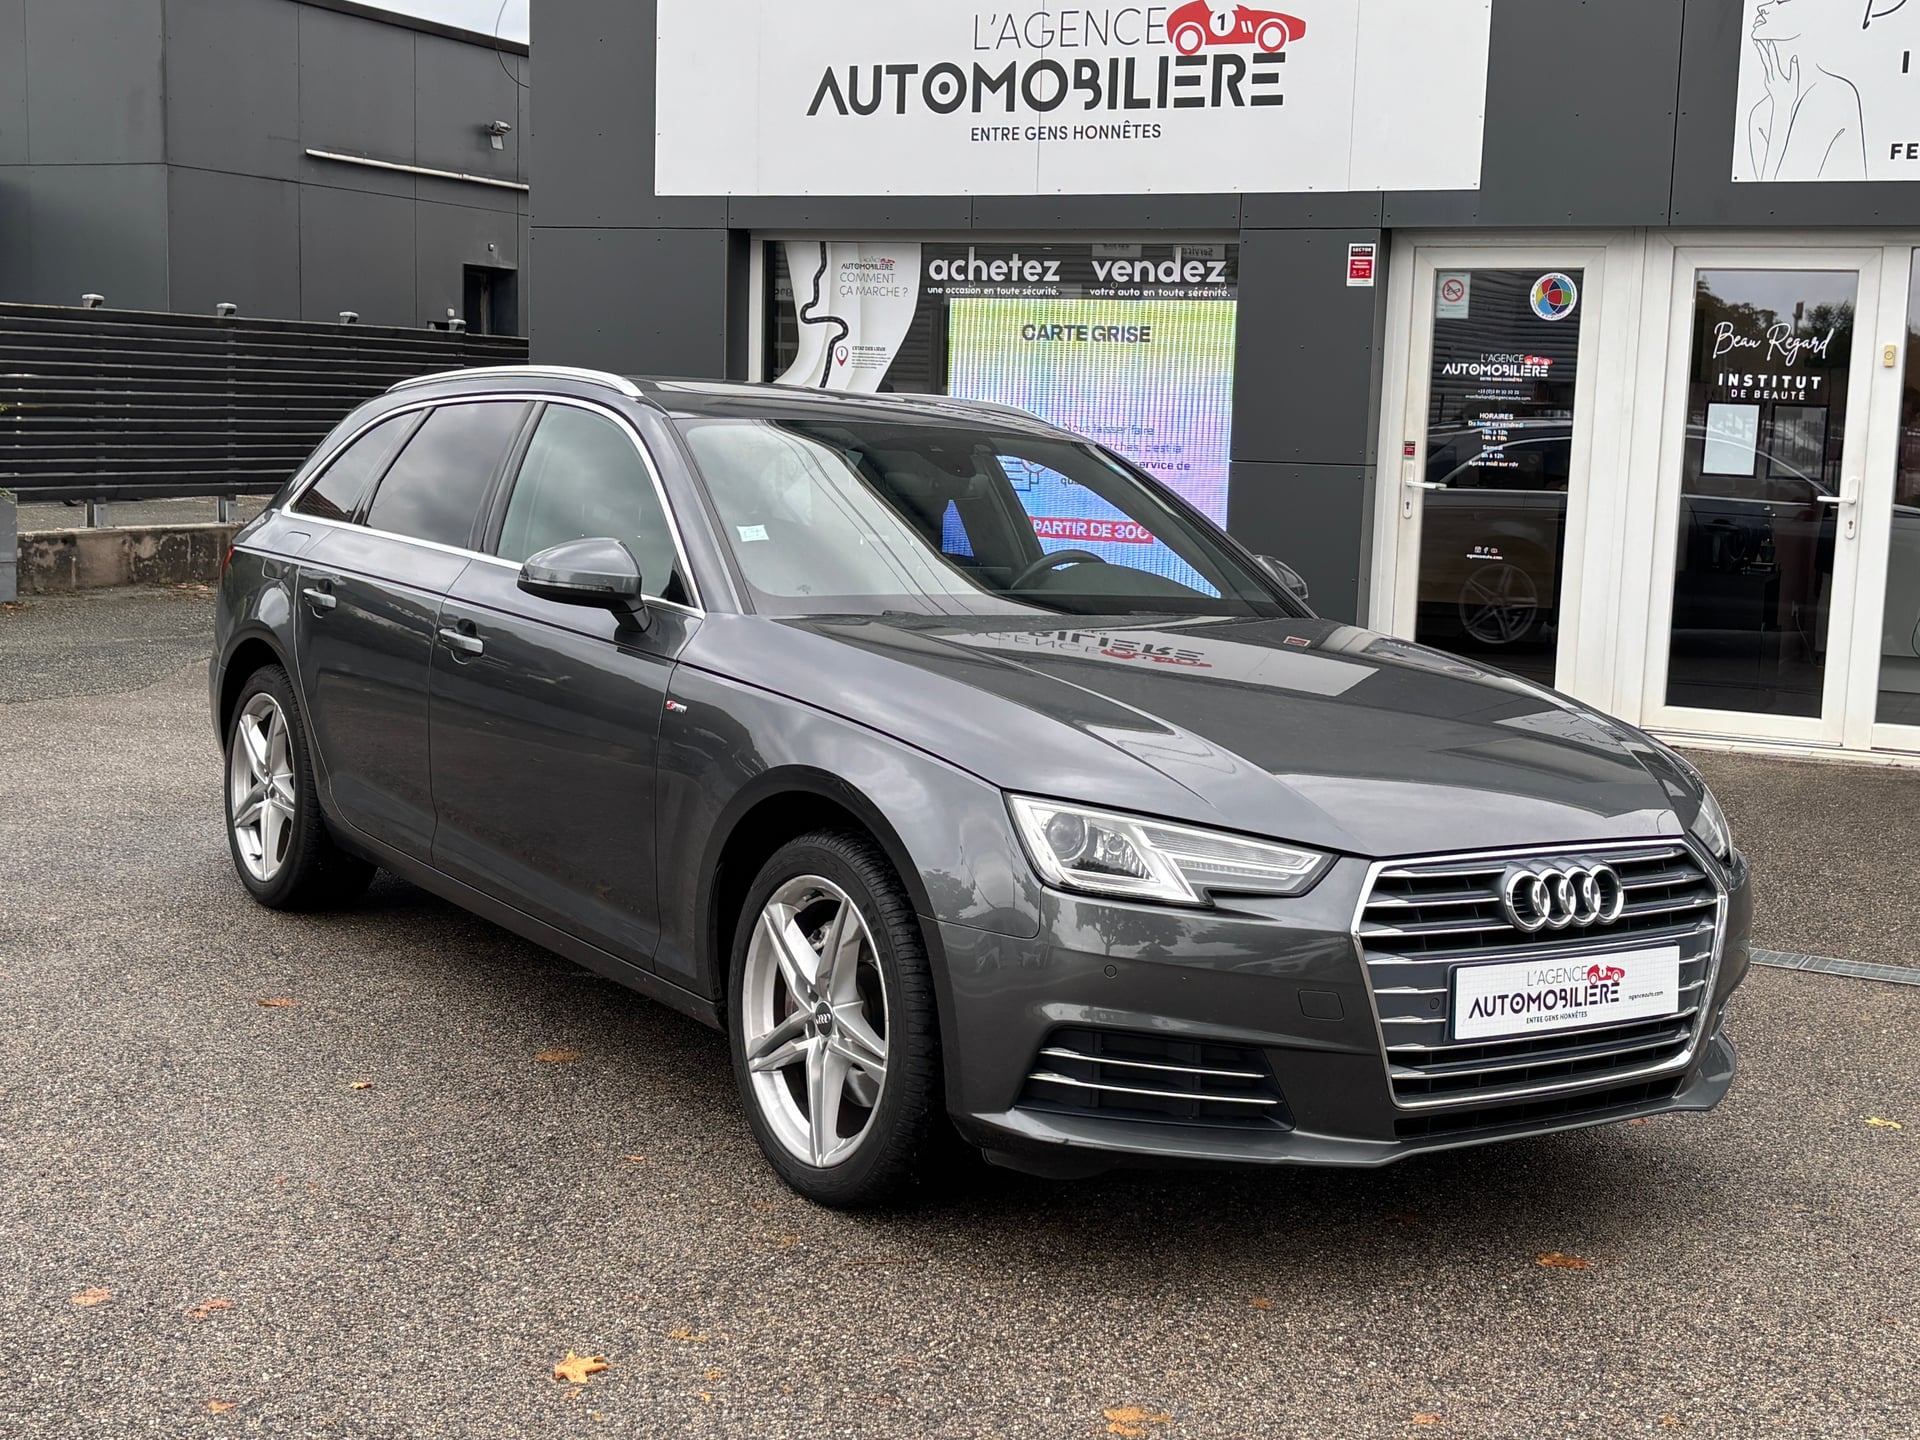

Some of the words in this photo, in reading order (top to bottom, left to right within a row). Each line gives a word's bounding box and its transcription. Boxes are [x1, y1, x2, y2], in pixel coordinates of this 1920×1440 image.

[974, 6, 1167, 51] L'AGENCE
[970, 126, 1020, 141] ENTRE
[1024, 125, 1068, 141] GENS
[1073, 119, 1162, 140] HONNÊTES
[928, 246, 1061, 282] achetez
[1091, 246, 1227, 283] vendez
[840, 272, 896, 284] COMMENT
[840, 286, 853, 297] ÇA
[856, 286, 900, 297] MARCHE
[903, 287, 909, 297] ?
[927, 286, 943, 294] une
[945, 285, 980, 295] occasion
[997, 286, 1020, 295] toute
[1022, 285, 1060, 296] sécurité.
[1089, 288, 1115, 296] votre
[1117, 288, 1140, 297] auto
[1158, 288, 1185, 297] toute
[1188, 287, 1231, 298] sérénité.
[1022, 324, 1088, 341] CARTE
[1092, 325, 1151, 343] GRISE
[1713, 321, 1761, 359] Beau
[1766, 323, 1835, 366] Regard
[1481, 354, 1524, 363] L'AGENCE
[1718, 373, 1821, 389] INSTITUT
[1731, 389, 1747, 398] DE
[1754, 390, 1805, 400] BEAUTÉ
[1176, 461, 1191, 471] de
[1033, 519, 1087, 536] PARTIR
[1090, 524, 1112, 538] DE
[1527, 965, 1588, 987] L'AGENCE
[1526, 1015, 1543, 1024] ENTRE
[1544, 1014, 1559, 1022] GENS
